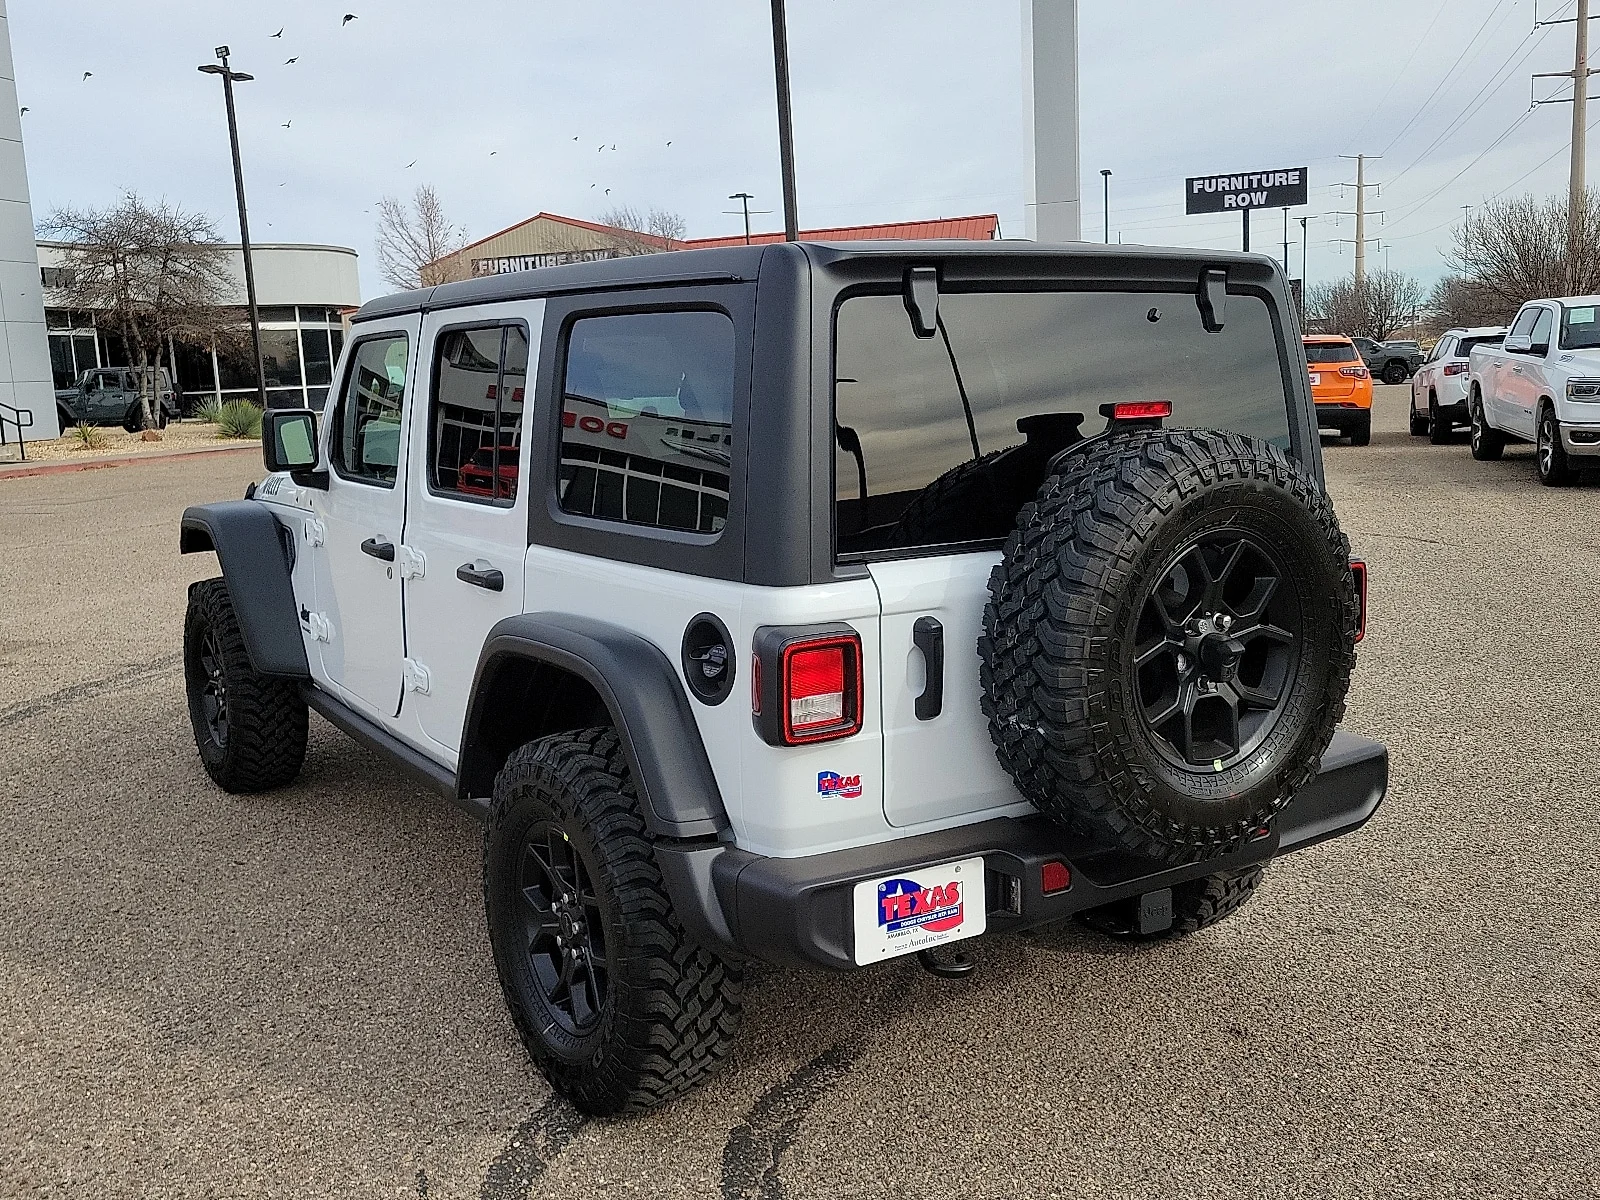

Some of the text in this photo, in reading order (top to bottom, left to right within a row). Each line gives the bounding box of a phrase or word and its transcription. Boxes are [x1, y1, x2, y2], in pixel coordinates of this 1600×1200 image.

[1193, 171, 1300, 194] FURNITURE
[1224, 191, 1268, 208] ROW
[819, 774, 861, 790] TEXAS
[881, 881, 960, 921] TEXAS
